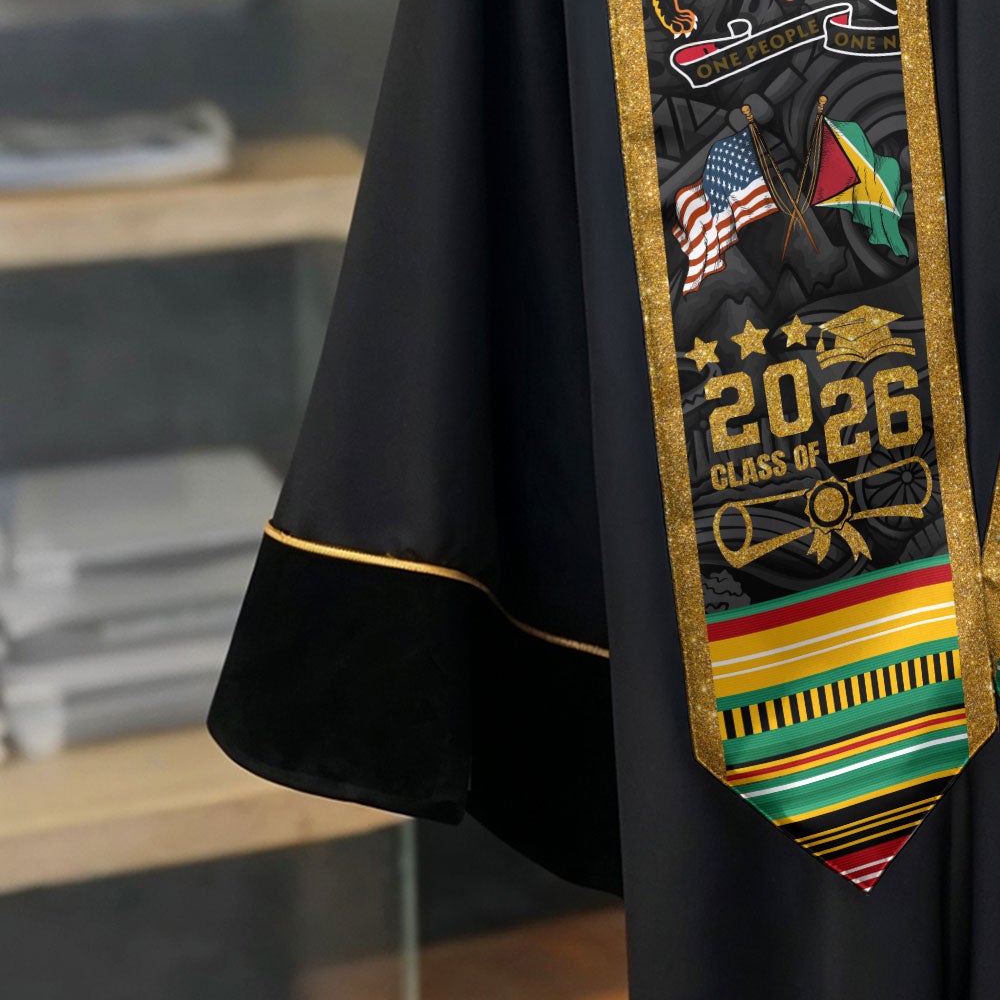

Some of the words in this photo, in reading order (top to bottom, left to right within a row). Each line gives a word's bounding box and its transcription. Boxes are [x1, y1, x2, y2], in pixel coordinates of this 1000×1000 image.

[696, 49, 742, 80] ONE
[747, 18, 820, 60] PEOPLE
[834, 31, 876, 51] ONE
[704, 358, 923, 464] 2026
[710, 450, 788, 491] CLASS
[793, 441, 820, 472] OF
